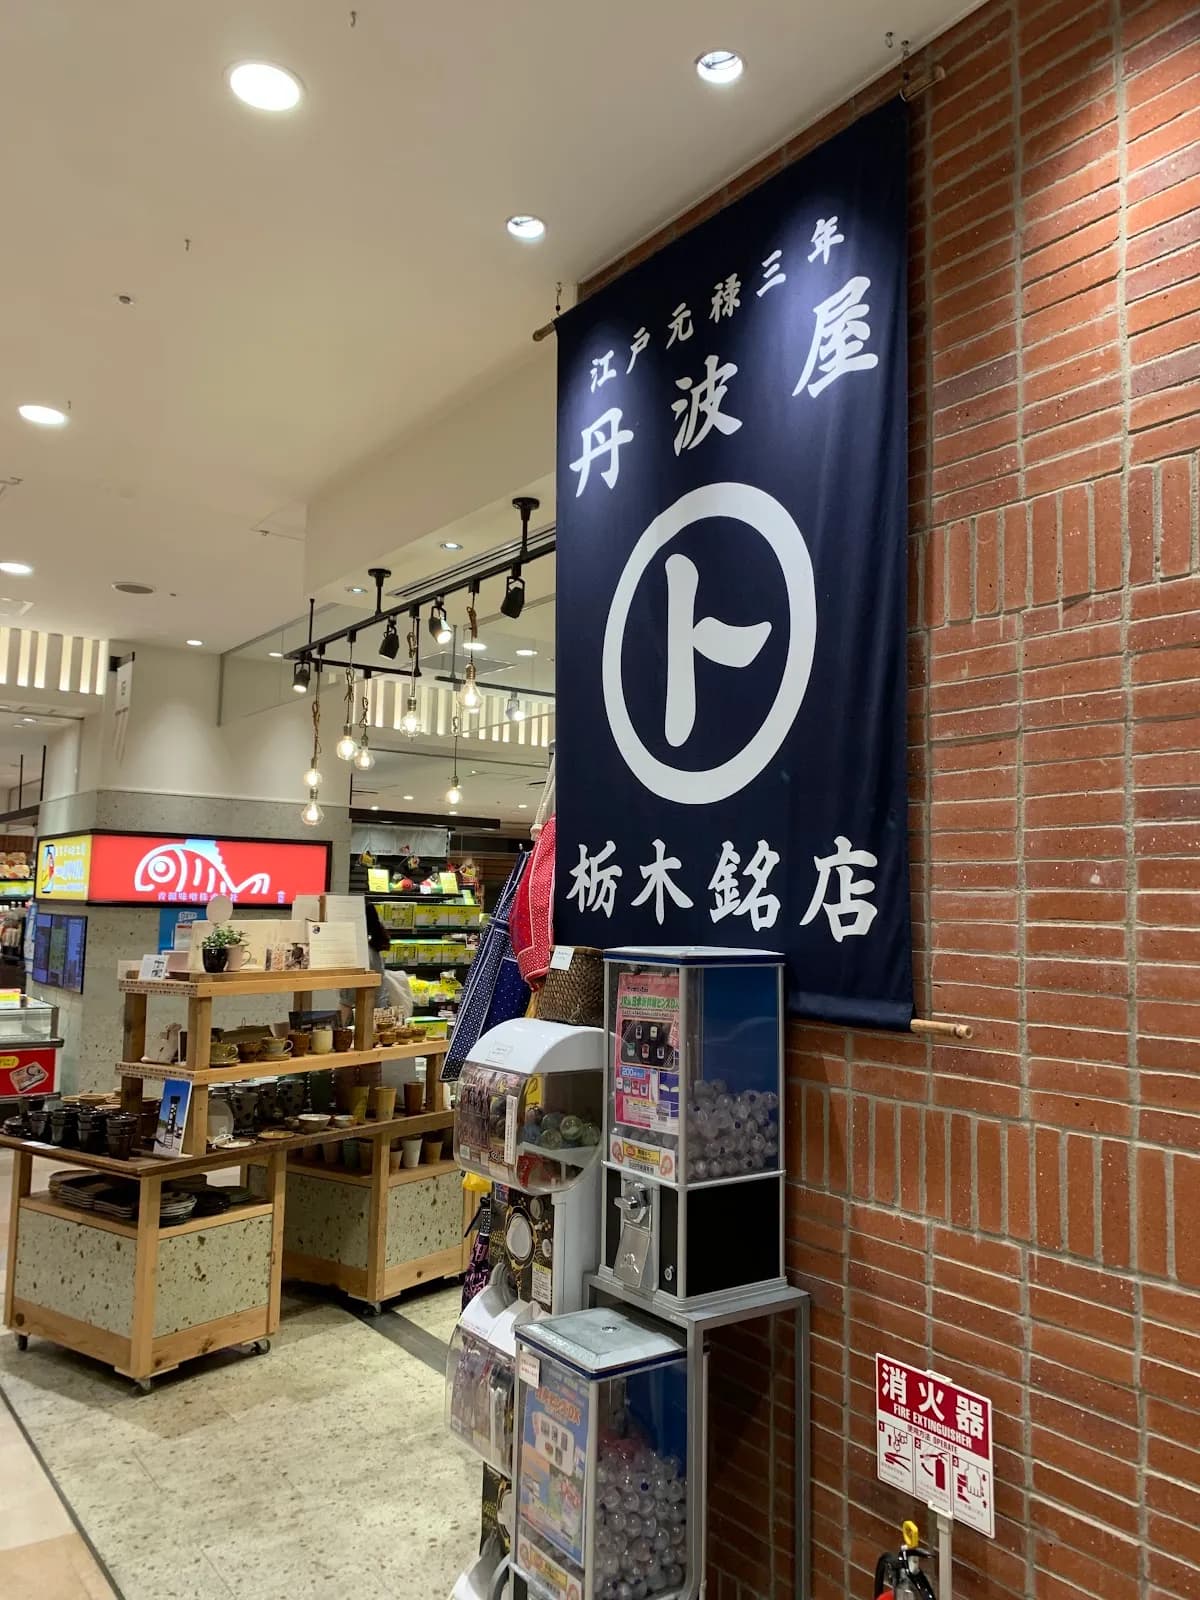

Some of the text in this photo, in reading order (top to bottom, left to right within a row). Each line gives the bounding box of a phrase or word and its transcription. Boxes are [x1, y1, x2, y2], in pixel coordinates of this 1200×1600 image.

[590, 216, 844, 393] 江戸元禄三年
[569, 276, 879, 498] 丹波屋
[566, 836, 878, 942] 栃木銘店
[882, 1363, 984, 1441] 消火器
[893, 1403, 972, 1449] FIRE EXTINGUISHER
[933, 1436, 958, 1454] OPERATE
